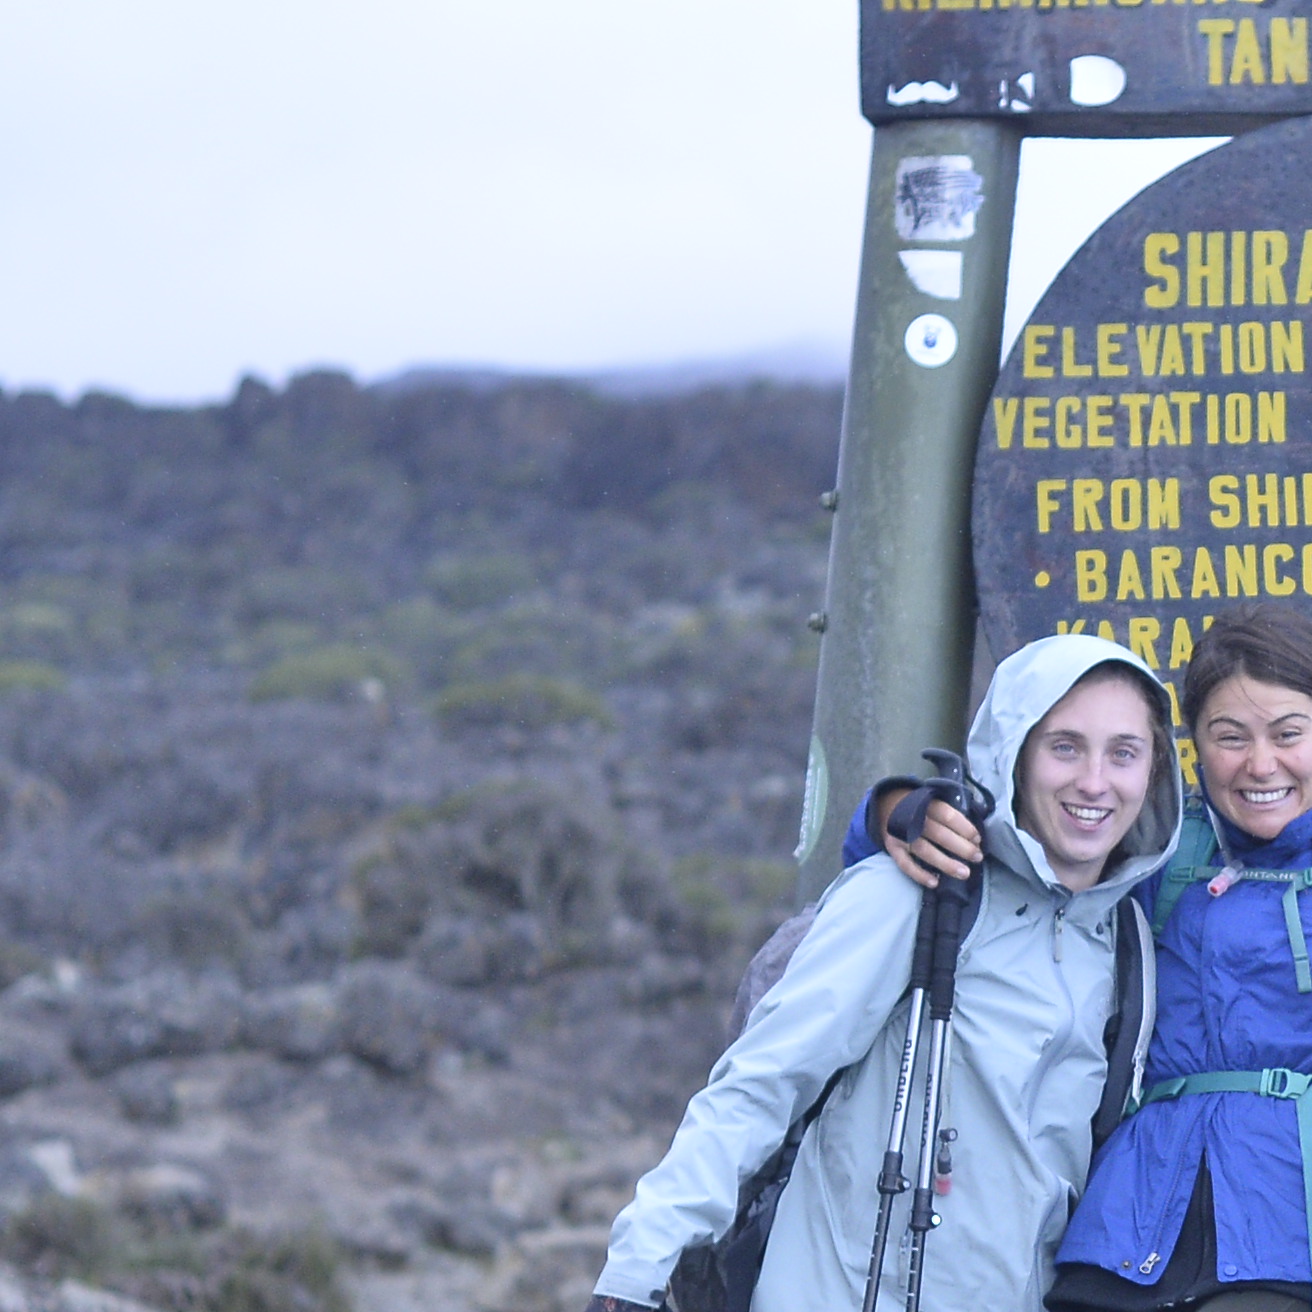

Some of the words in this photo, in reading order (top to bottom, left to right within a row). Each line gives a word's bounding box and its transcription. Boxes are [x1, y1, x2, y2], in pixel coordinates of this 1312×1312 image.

[1024, 321, 1305, 378] ELEVATION
[994, 392, 1286, 449] VEGETATION
[1037, 478, 1180, 533] FROM
